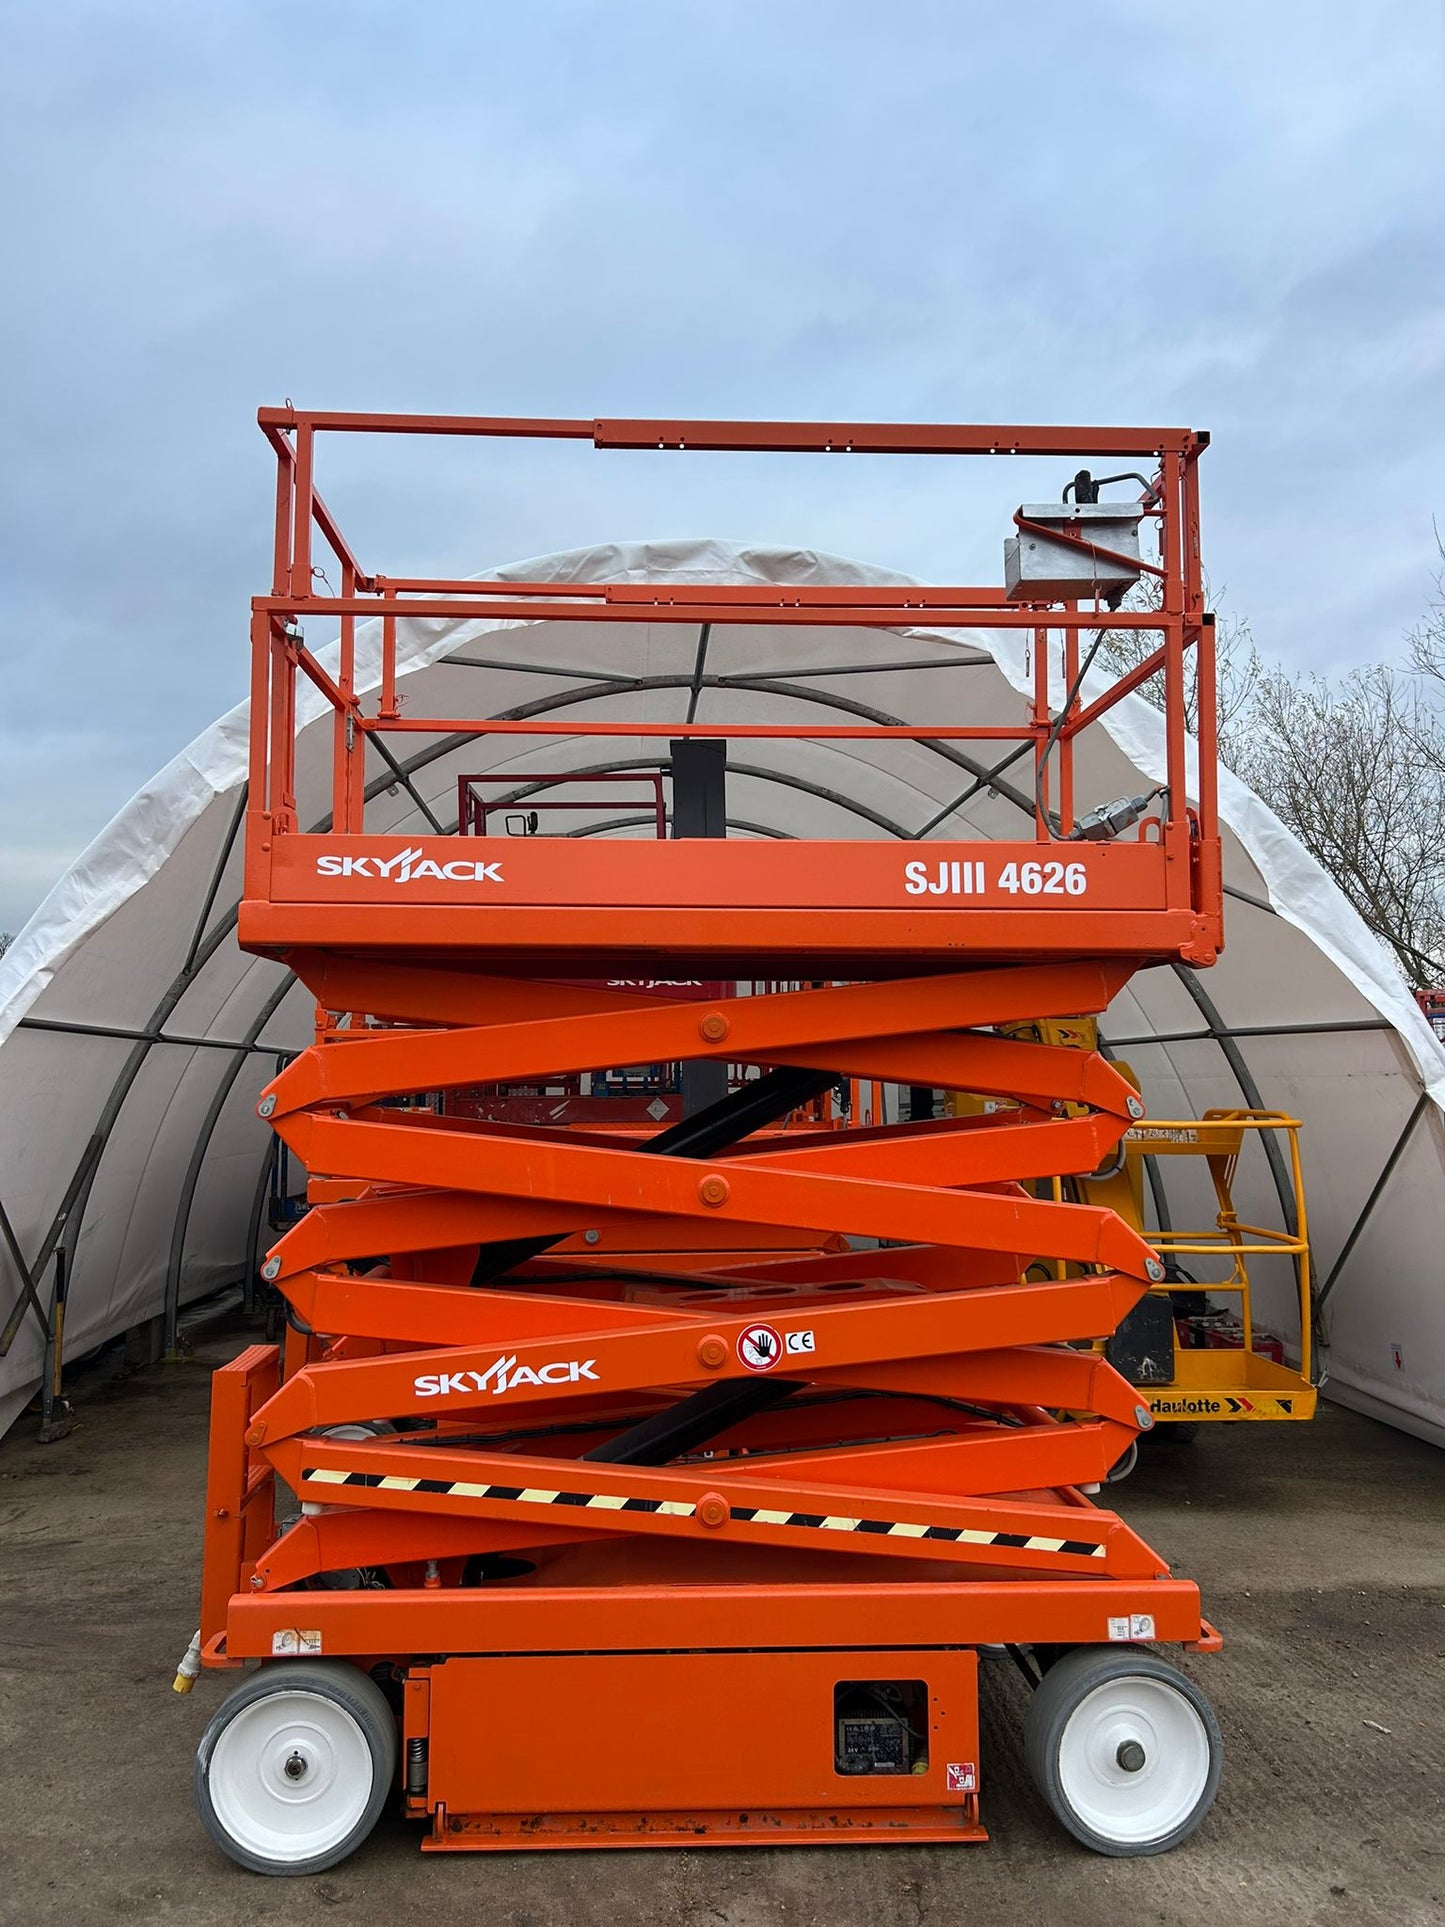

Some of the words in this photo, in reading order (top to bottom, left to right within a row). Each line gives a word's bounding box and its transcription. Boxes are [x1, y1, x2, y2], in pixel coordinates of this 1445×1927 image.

[317, 847, 504, 882] SKYJACK
[905, 861, 985, 894] SJIII
[998, 861, 1087, 895] 4626
[414, 1355, 600, 1396] SKYJACK
